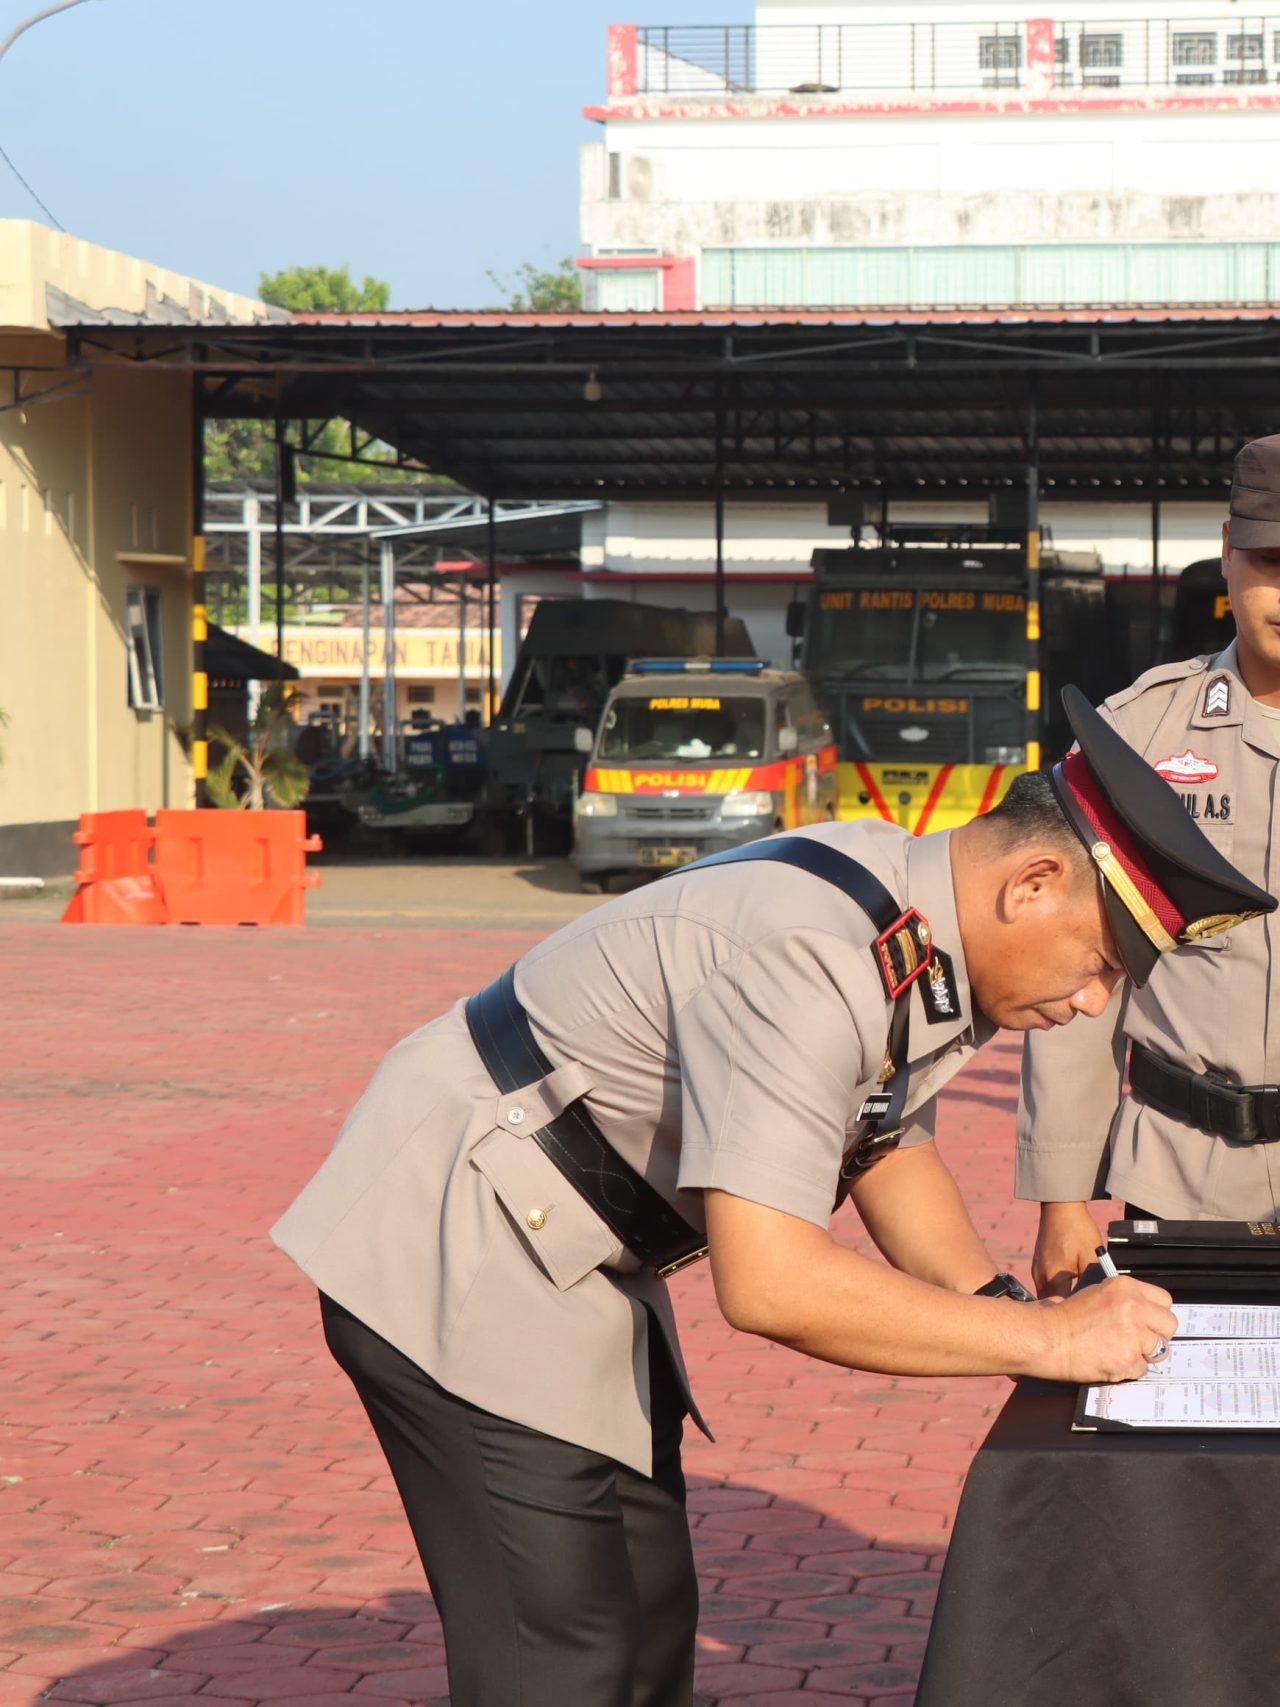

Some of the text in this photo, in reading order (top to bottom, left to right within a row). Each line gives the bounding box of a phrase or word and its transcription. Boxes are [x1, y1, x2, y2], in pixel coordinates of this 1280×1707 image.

[820, 592, 854, 609] UNIT
[920, 592, 975, 609] POLRES
[862, 697, 968, 712] POLISI
[635, 773, 706, 787] POLISI
[1204, 793, 1230, 820] A.S
